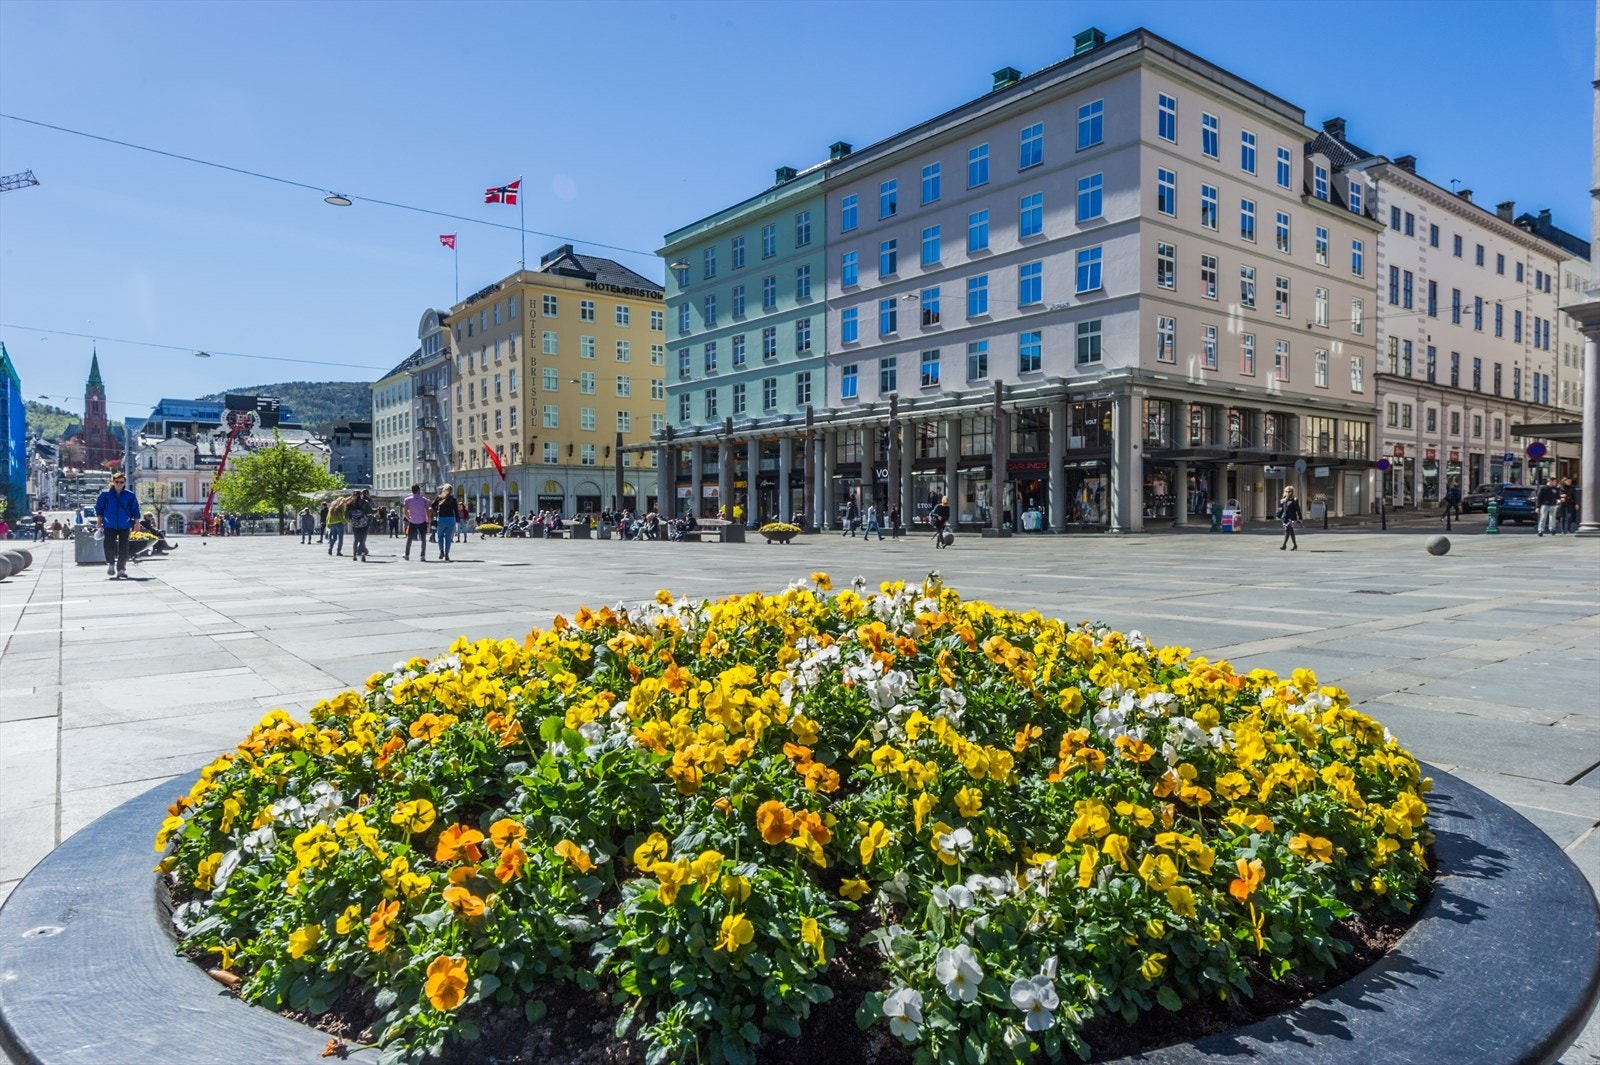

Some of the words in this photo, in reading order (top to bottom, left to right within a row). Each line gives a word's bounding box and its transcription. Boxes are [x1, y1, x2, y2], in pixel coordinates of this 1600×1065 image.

[591, 281, 622, 293] HOTEL
[624, 286, 663, 300] BRISTOL
[529, 299, 537, 349] HOTEL
[530, 357, 538, 427] BRISTOL
[876, 468, 889, 478] VO
